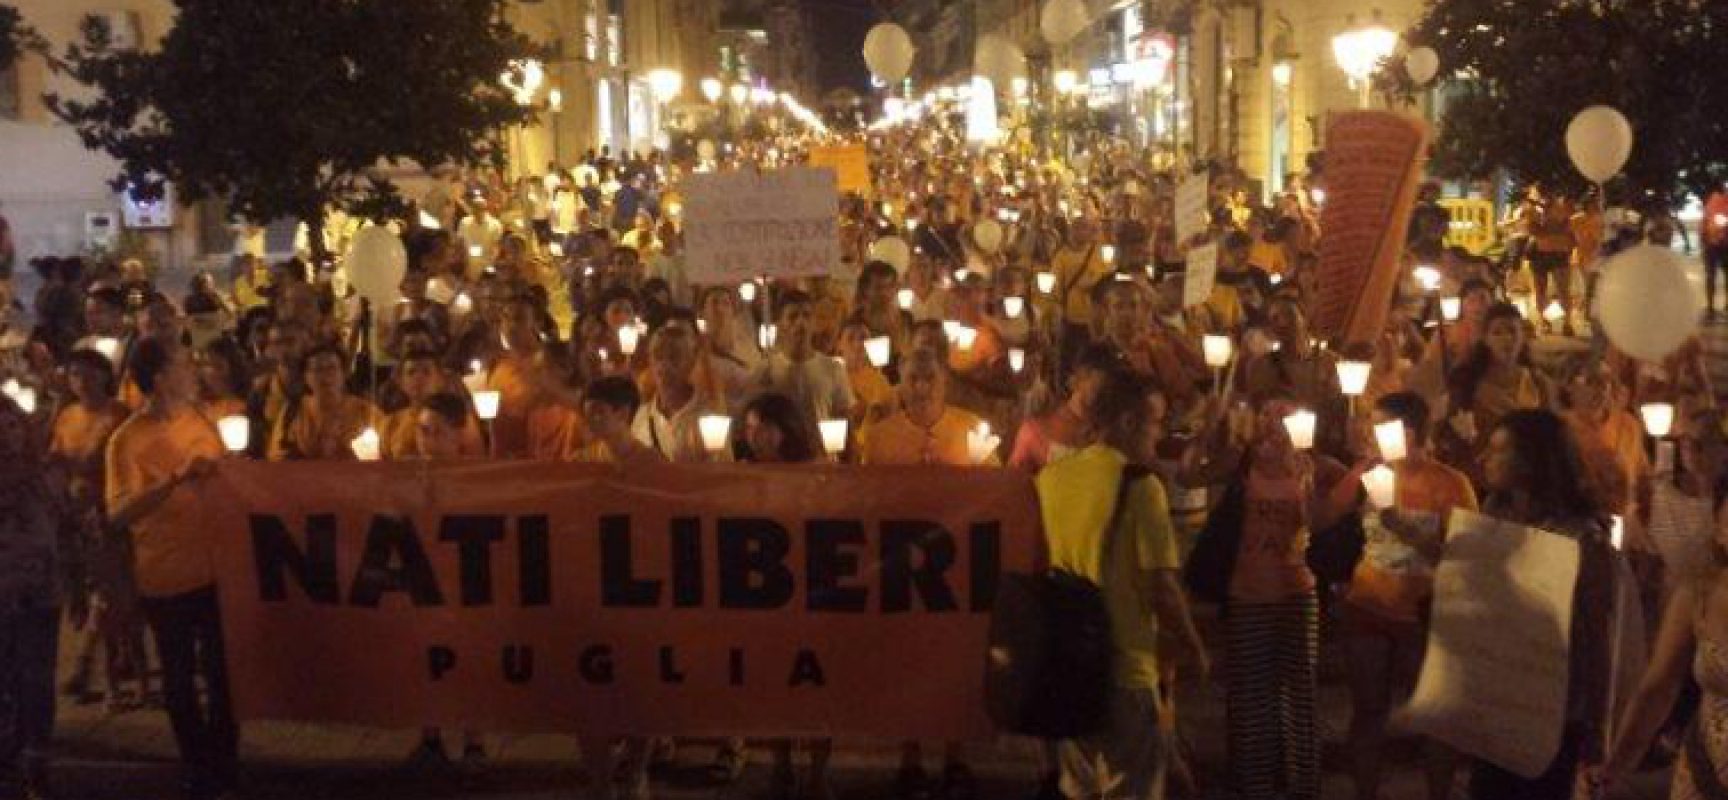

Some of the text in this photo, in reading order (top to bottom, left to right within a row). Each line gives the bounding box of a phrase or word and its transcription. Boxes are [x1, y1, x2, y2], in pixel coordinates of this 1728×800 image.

[249, 513, 1001, 614] NATI LIBERI
[428, 645, 827, 687] PUGLIA
